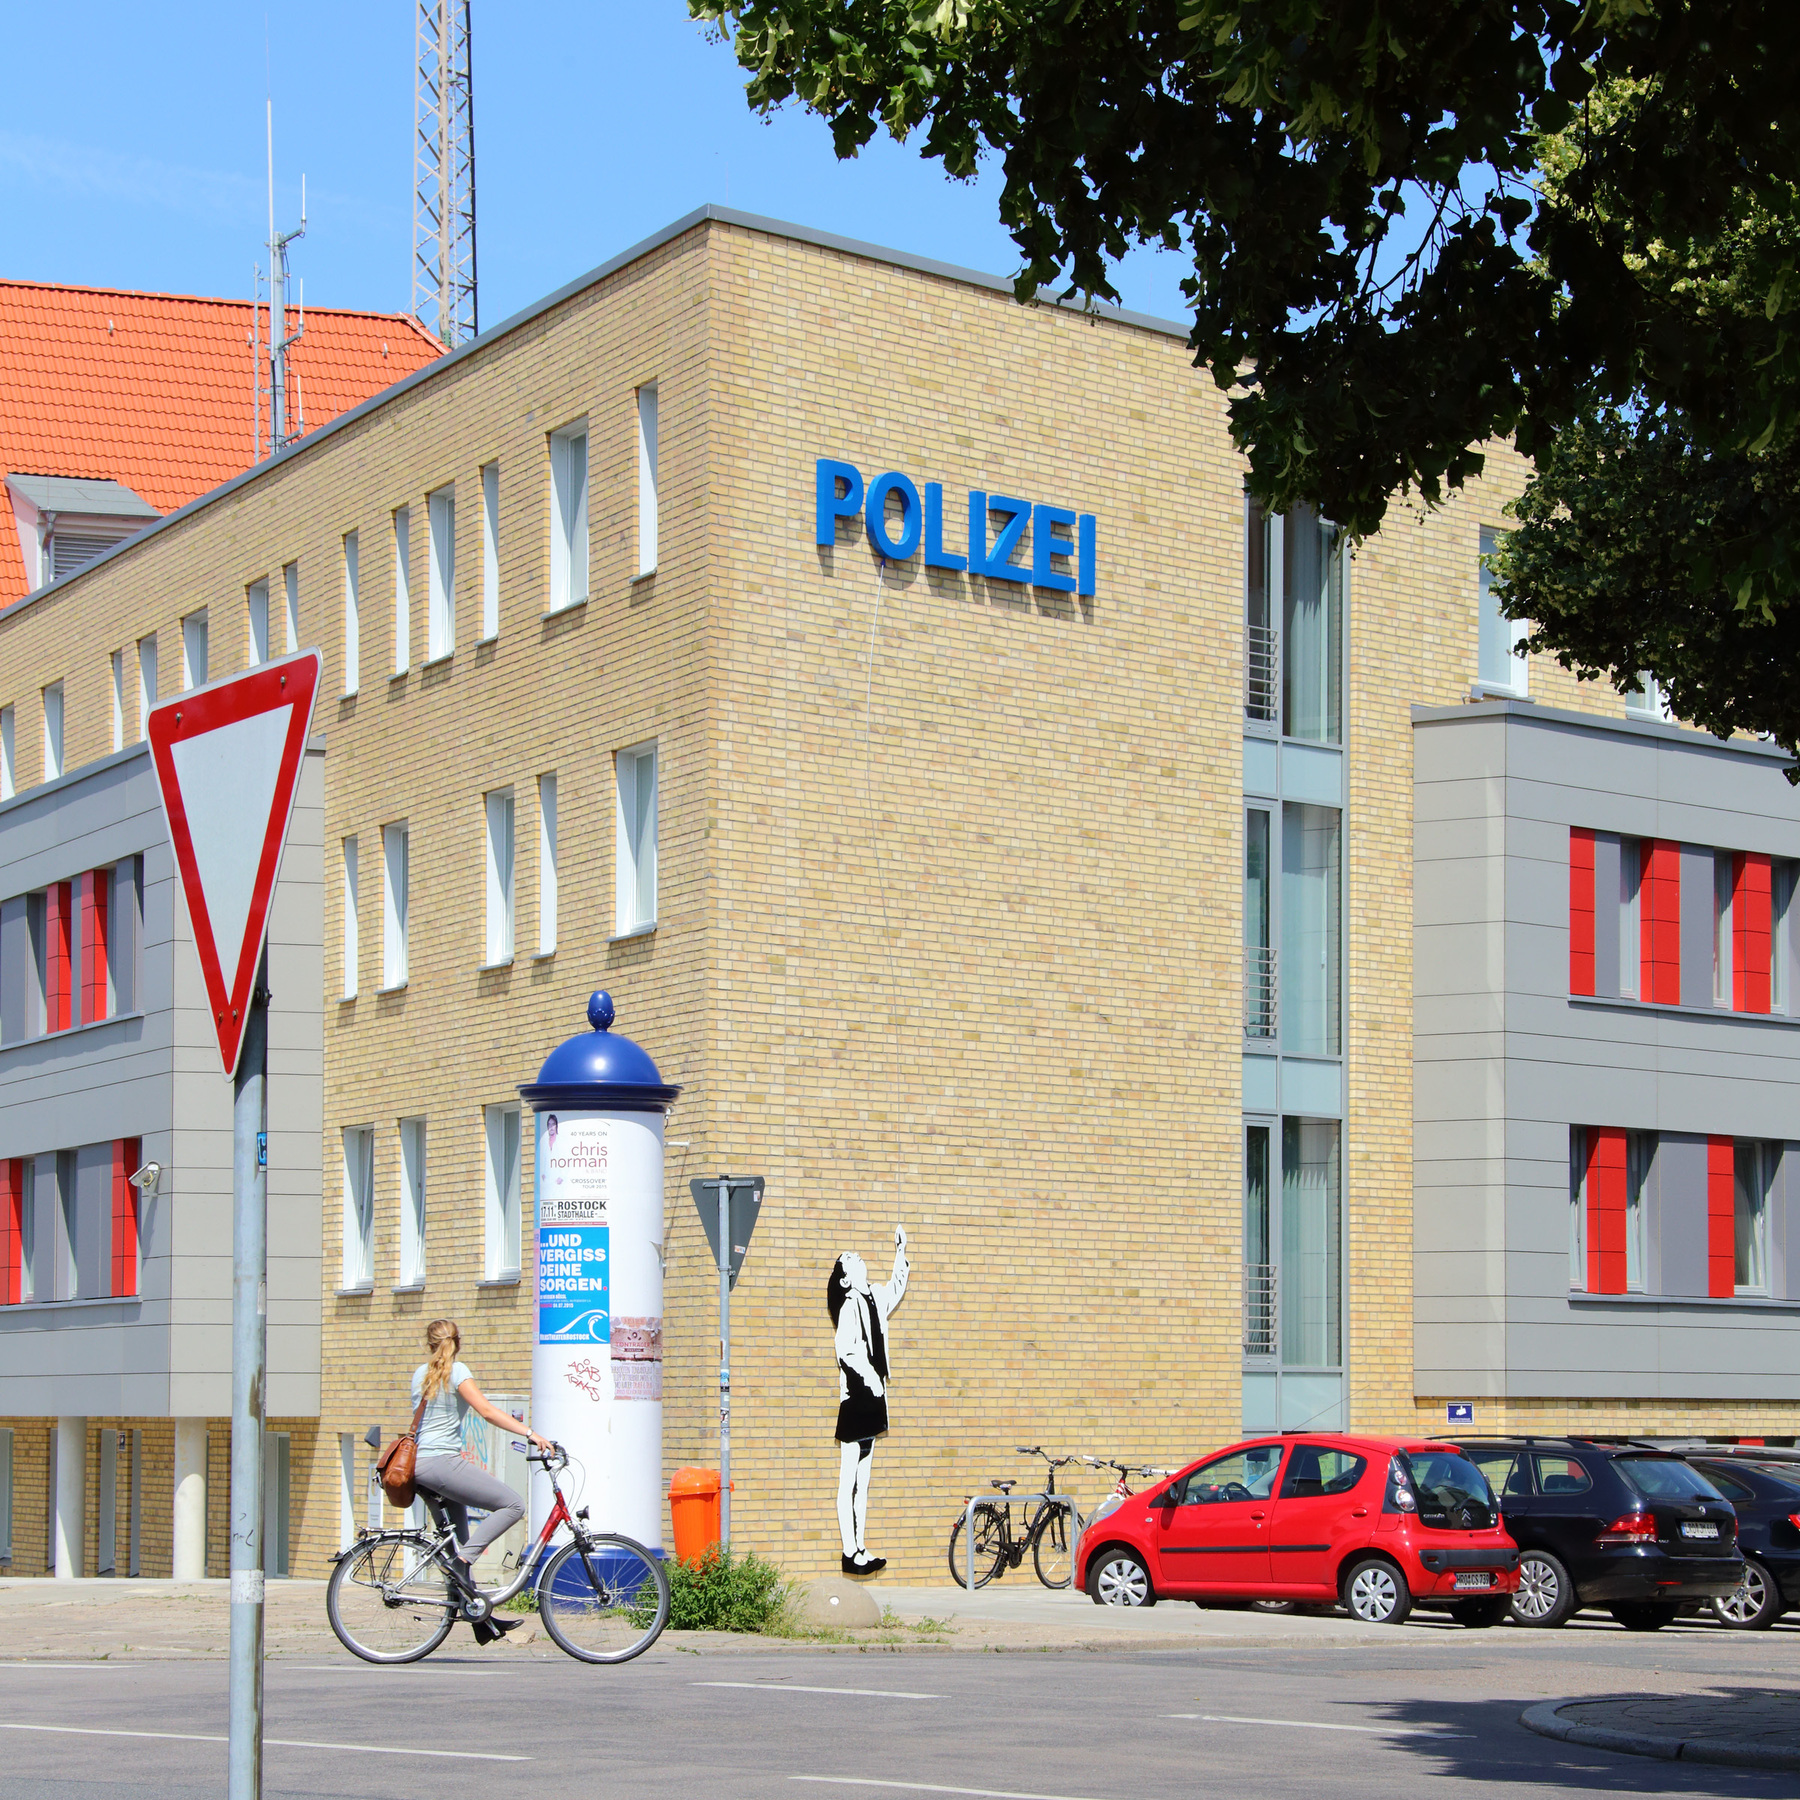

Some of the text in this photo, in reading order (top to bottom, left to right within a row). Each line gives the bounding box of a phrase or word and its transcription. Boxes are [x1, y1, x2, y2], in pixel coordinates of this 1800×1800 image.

[816, 458, 1096, 596] POLIZEI
[571, 1141, 608, 1156] chris
[550, 1157, 608, 1168] norman
[557, 1201, 607, 1210] ROSTOCK
[557, 1210, 595, 1219] STADTHALLE
[540, 1248, 606, 1262] VERGISS
[540, 1263, 582, 1277] DEINE
[540, 1278, 608, 1291] SORGEN.
